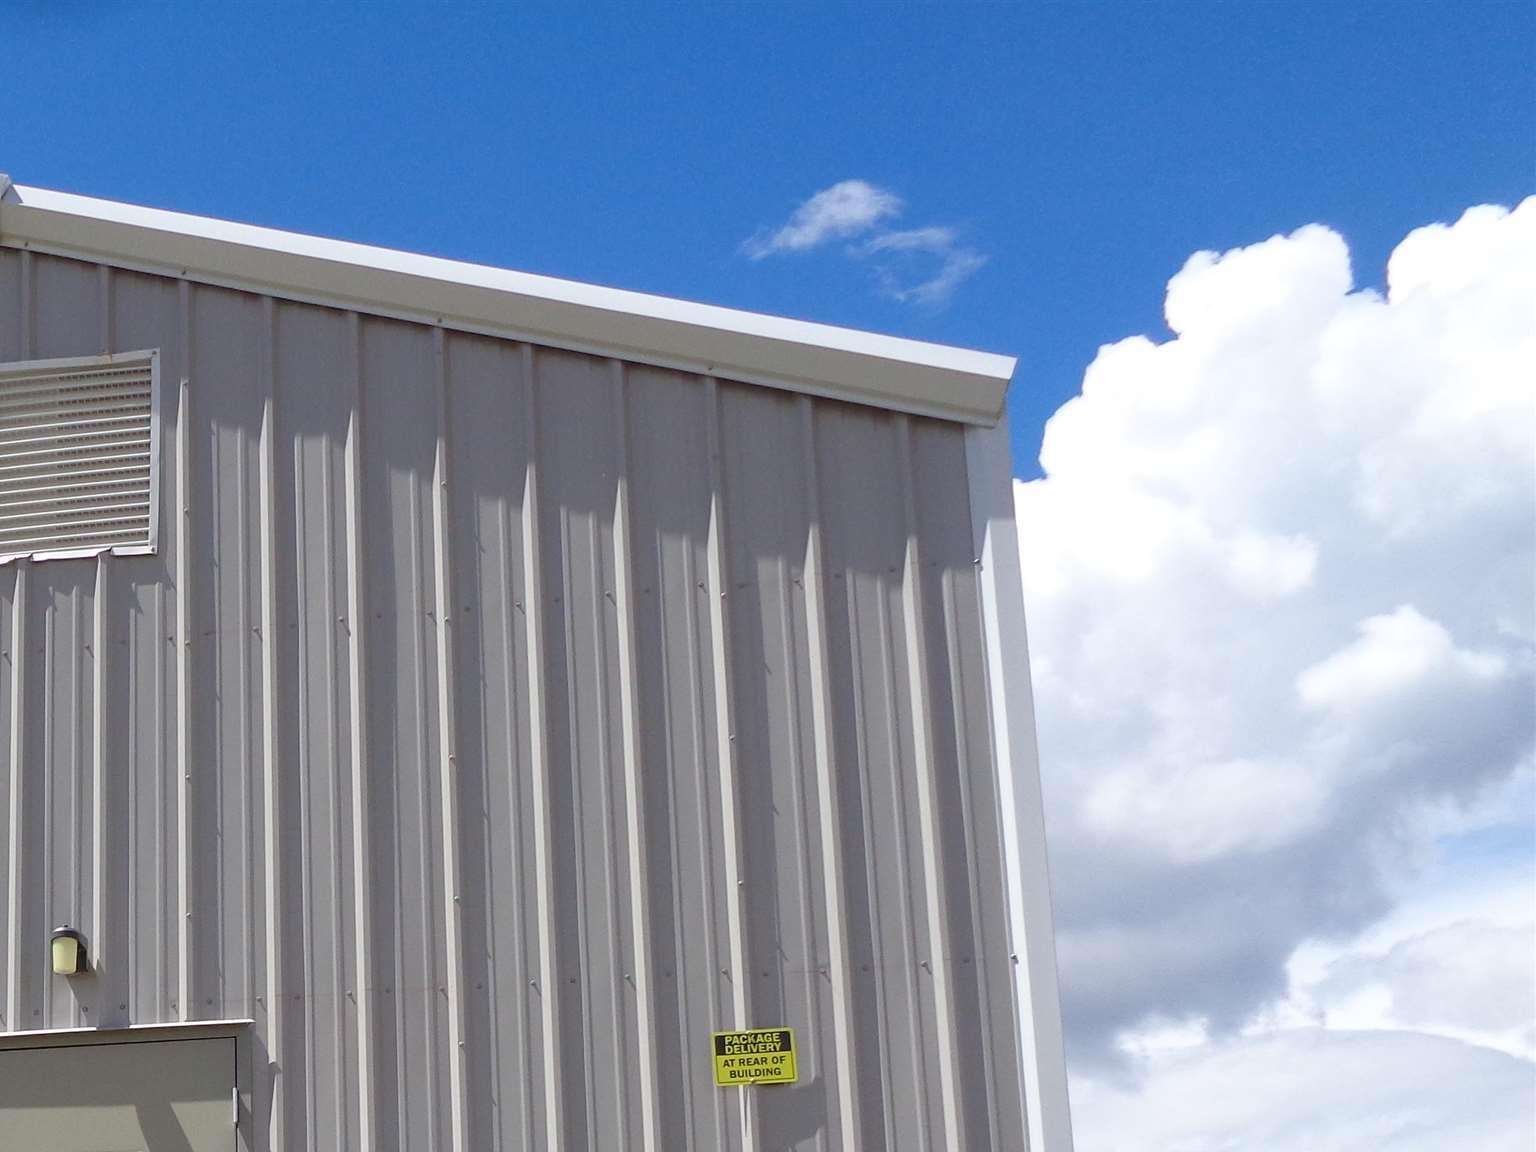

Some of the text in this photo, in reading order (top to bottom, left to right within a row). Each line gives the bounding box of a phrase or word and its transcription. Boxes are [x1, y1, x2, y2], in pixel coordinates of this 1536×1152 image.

[724, 1032, 781, 1045] PACKAGE
[724, 1042, 782, 1055] DELIVERY
[723, 1055, 786, 1067] AT REAR OF
[729, 1067, 782, 1079] BUILDING
